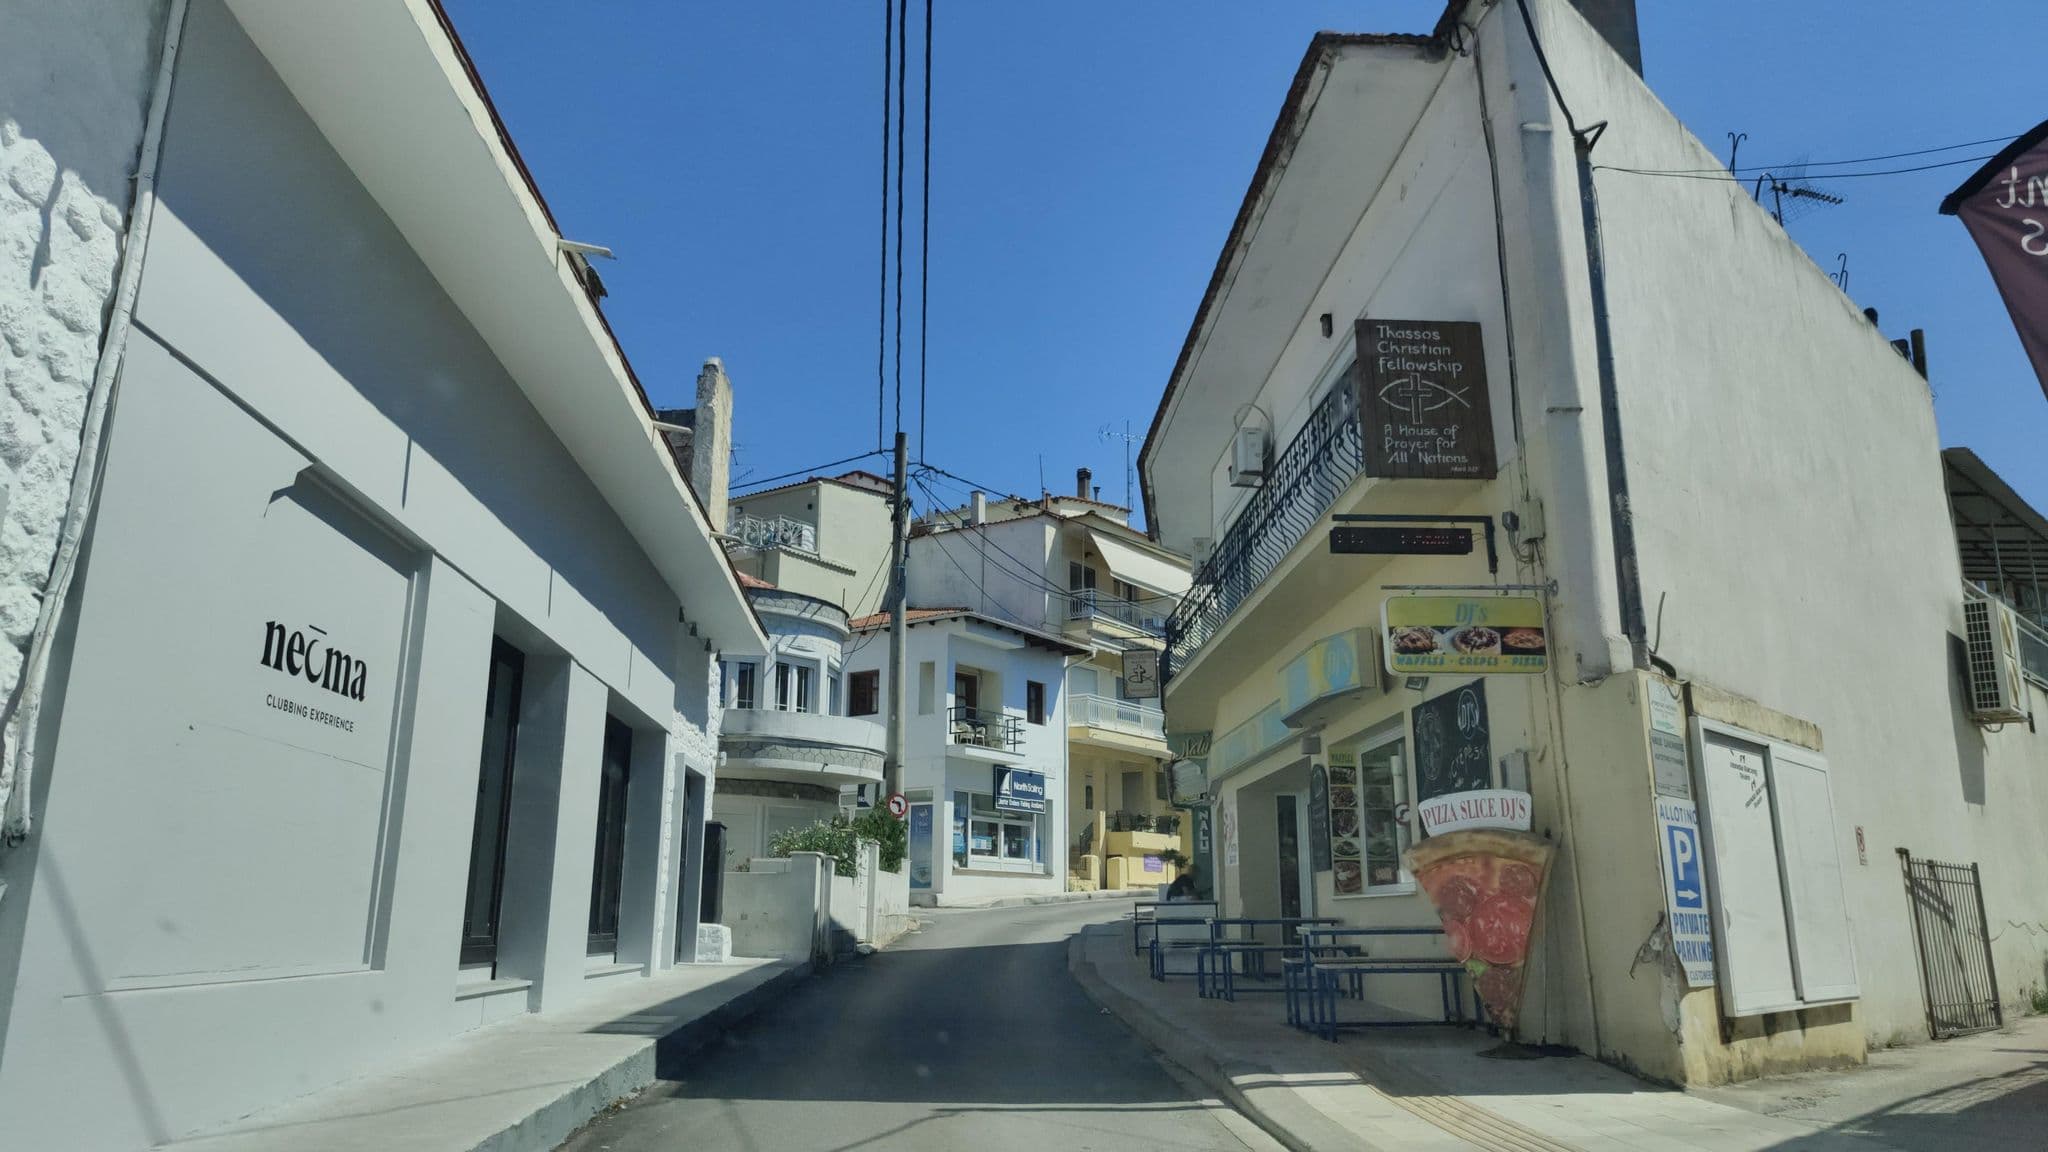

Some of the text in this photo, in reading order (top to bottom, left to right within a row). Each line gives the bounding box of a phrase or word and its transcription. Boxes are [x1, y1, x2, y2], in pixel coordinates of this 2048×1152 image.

[1376, 325, 1441, 340] Thassos
[1377, 341, 1451, 356] Christian
[1378, 357, 1463, 379] Fellowship
[1384, 424, 1460, 440] A House of
[1384, 437, 1457, 453] Prayer for
[1388, 450, 1468, 465] All Nations
[1458, 656, 1499, 666] CREPES
[266, 694, 355, 732] CLUBBING EXPERIENCE
[1423, 797, 1527, 828] PIZZA SLICE DJ'S
[1673, 830, 1692, 881] P
[1673, 912, 1709, 935] PRIVATE
[1676, 940, 1713, 963] PARKING
